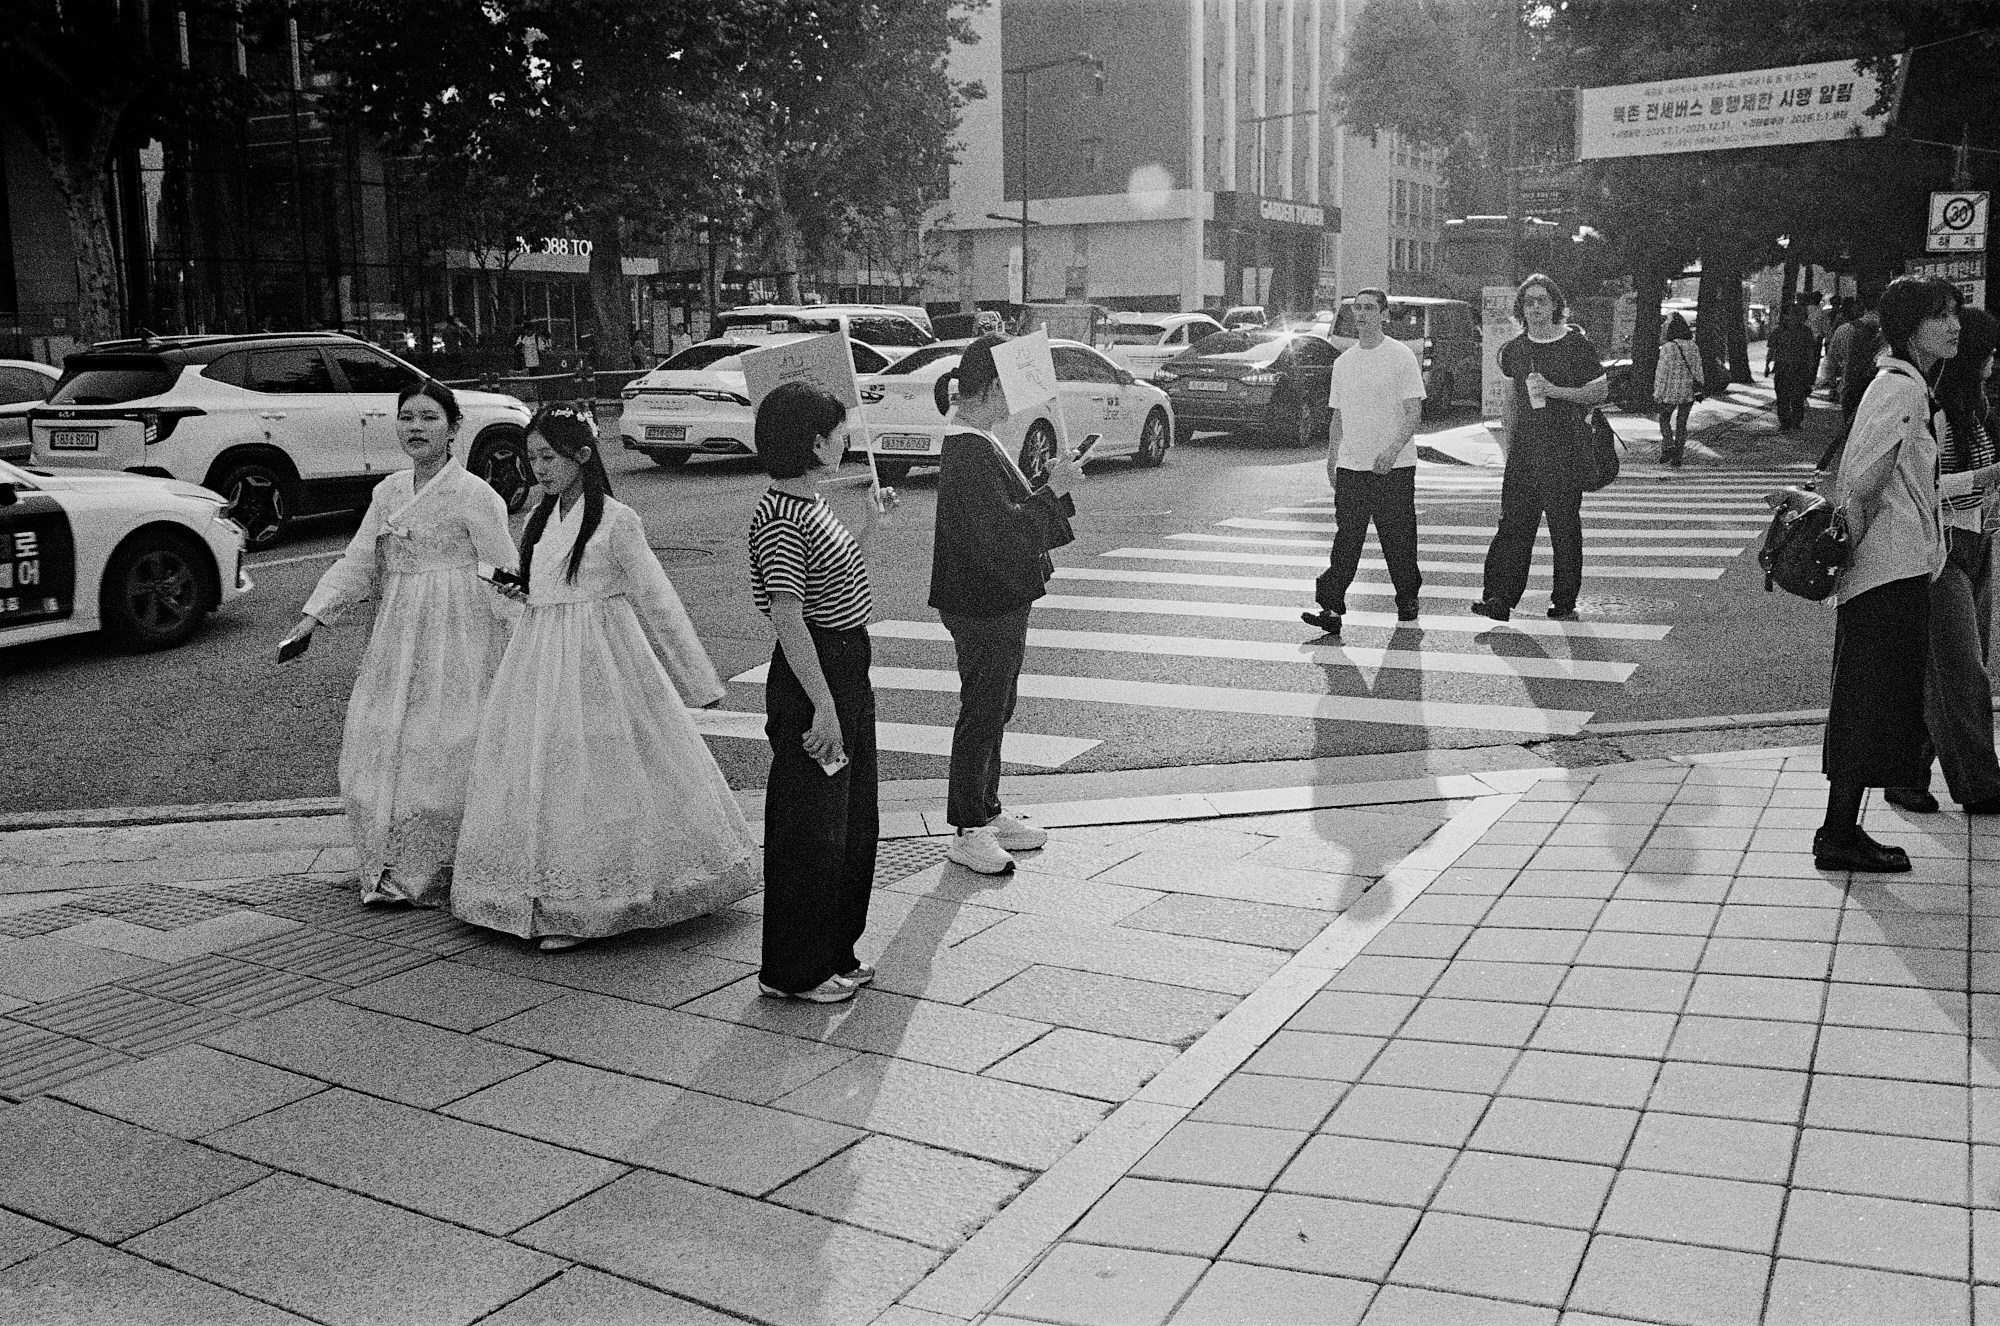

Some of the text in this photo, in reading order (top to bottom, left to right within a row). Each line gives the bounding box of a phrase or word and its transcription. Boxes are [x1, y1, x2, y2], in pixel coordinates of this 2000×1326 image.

[1613, 82, 1854, 124] 북촌 전세버스 통행제한 시행 알림
[1260, 200, 1295, 222] GARDEN
[1949, 205, 1968, 222] 30
